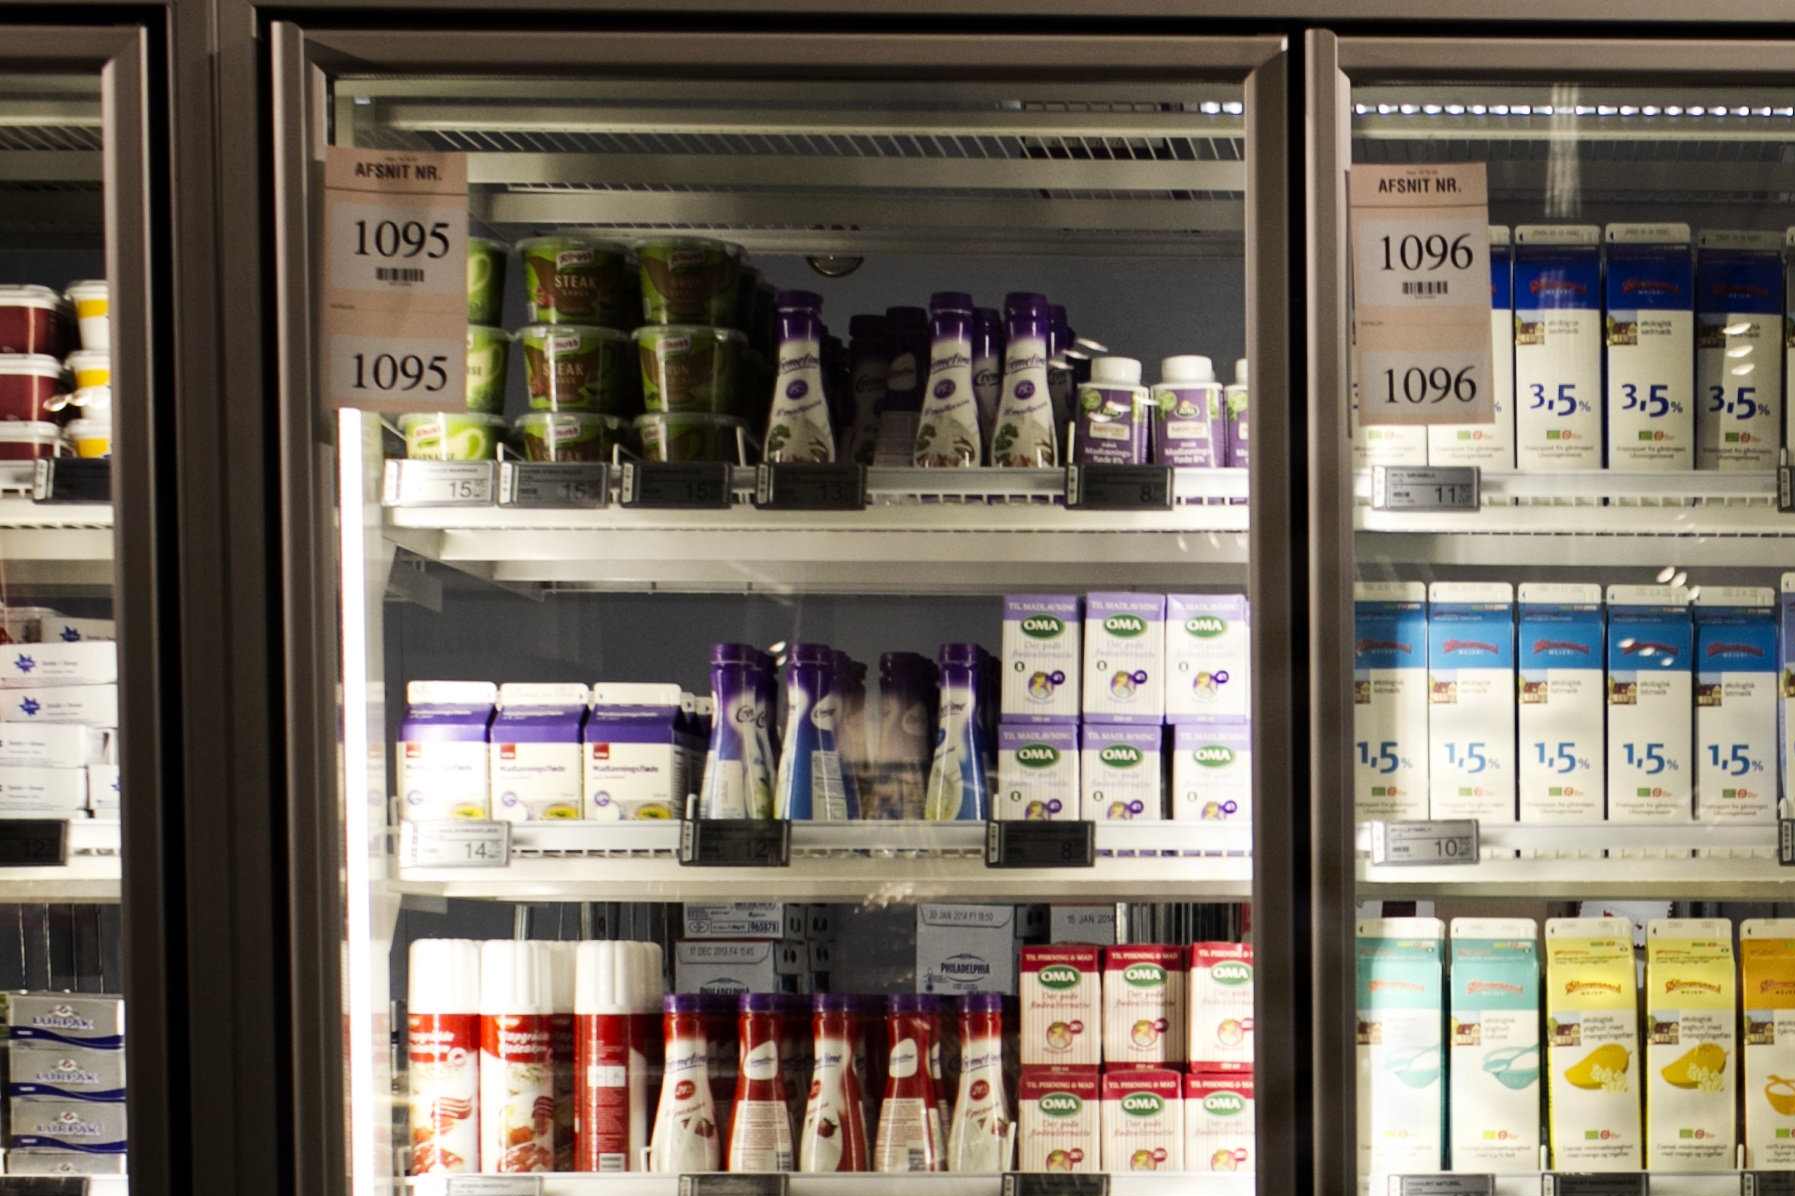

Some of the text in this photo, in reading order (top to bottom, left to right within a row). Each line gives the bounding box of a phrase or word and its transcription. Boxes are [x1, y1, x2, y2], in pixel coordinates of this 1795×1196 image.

[355, 162, 442, 181] AFSNIT NR.
[1378, 177, 1462, 193] AFSNIT NR.
[354, 220, 450, 258] 1095
[1382, 233, 1473, 271] 1096
[554, 275, 597, 289] STEAK
[353, 354, 448, 391] 1095
[1384, 366, 1477, 404] 1096
[1529, 383, 1591, 417] 3,5%
[1622, 383, 1683, 418] 3,5%
[1709, 385, 1770, 420] 3,5%
[449, 482, 472, 497] 15
[1435, 485, 1458, 503] 11
[1023, 619, 1059, 632] OMA
[1105, 618, 1140, 631] OMA
[1186, 619, 1221, 632] OMA
[1018, 748, 1054, 761] OMA
[1101, 748, 1138, 761] OMA
[1195, 748, 1230, 762] OMA
[1357, 741, 1413, 774] 1,5%
[1444, 742, 1500, 774] 1,5%
[1534, 742, 1590, 774] 1,5%
[465, 842, 487, 859] 14
[1434, 840, 1457, 857] 10
[1080, 915, 1095, 924] JAN
[941, 963, 990, 974] PHILADELPHIA
[1125, 968, 1162, 981] OMA
[1213, 966, 1248, 980] OMA
[1041, 969, 1076, 983] OMA
[33, 1016, 94, 1029] LURPAK
[36, 1072, 99, 1083] LURPAK
[1041, 1098, 1077, 1110] OMA
[1124, 1098, 1159, 1110] OMA
[1206, 1097, 1242, 1110] OMA
[36, 1124, 100, 1135] LURPAK
